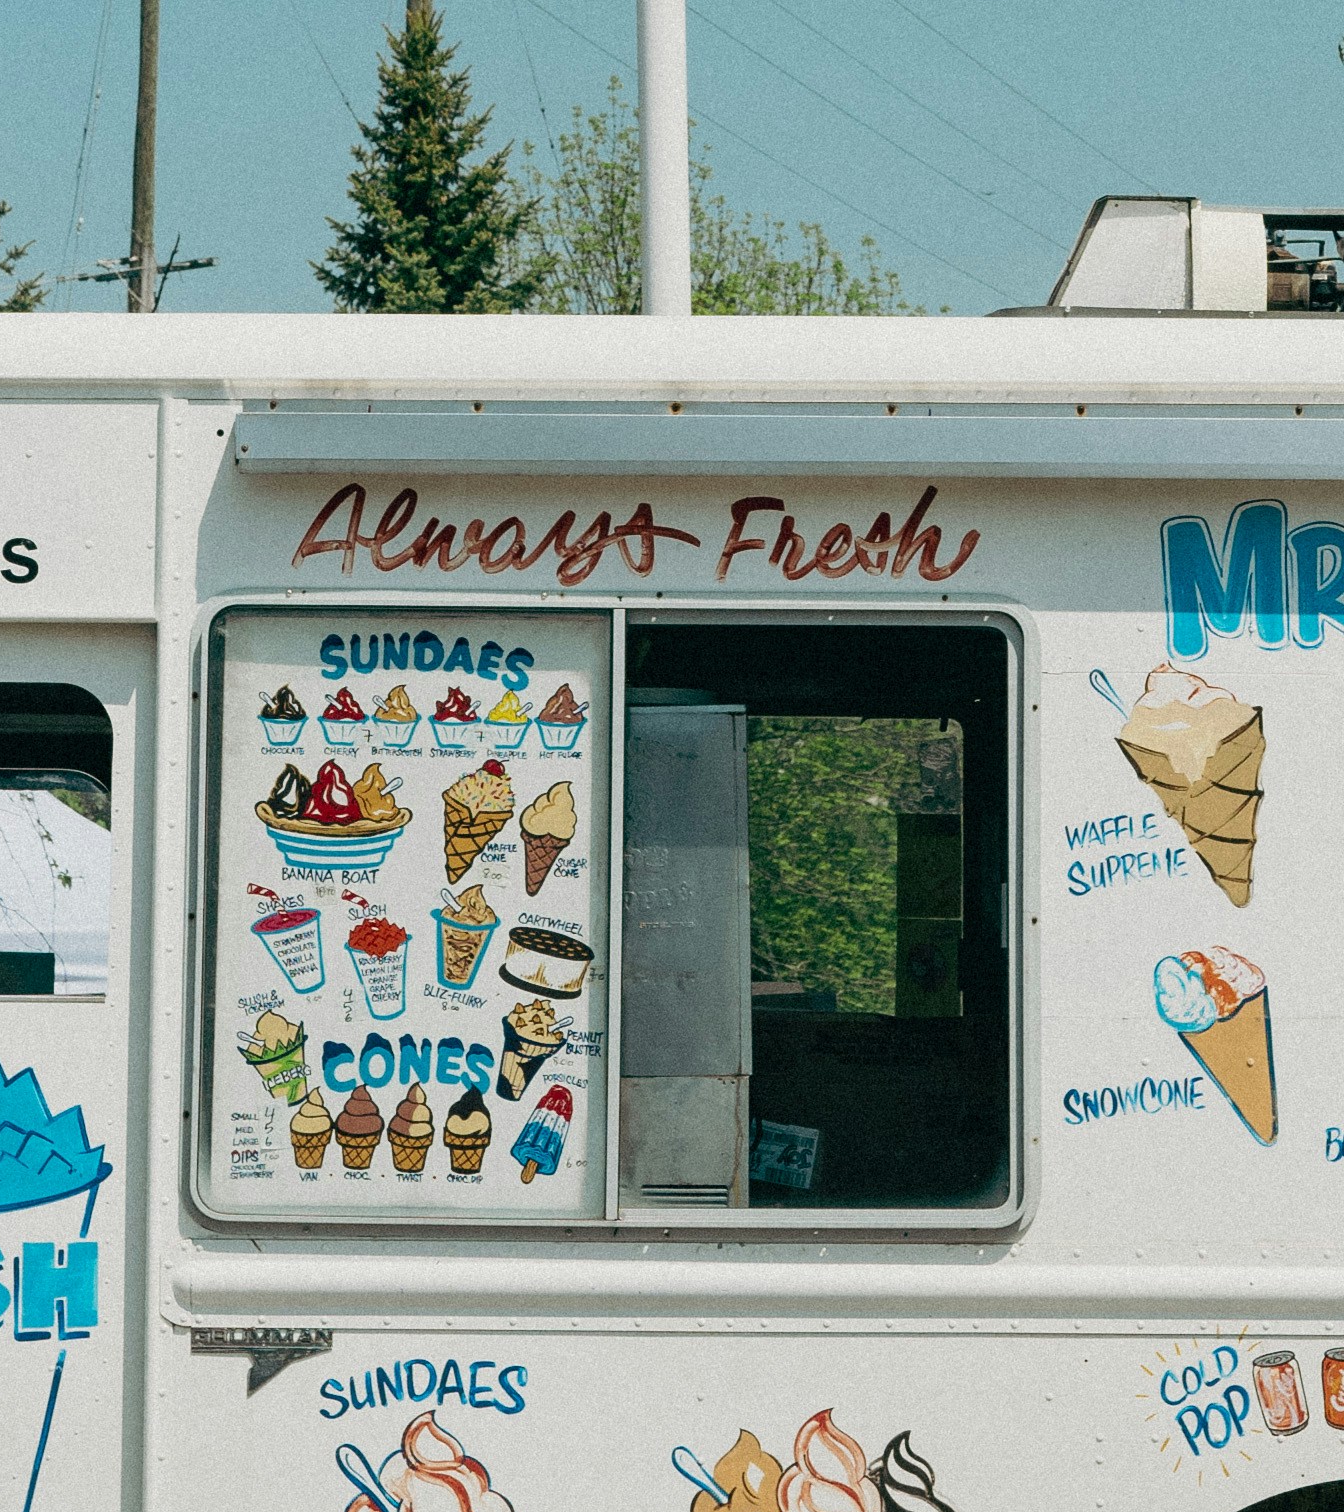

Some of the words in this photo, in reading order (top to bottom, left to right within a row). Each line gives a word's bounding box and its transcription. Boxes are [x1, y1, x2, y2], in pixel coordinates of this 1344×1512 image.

[292, 483, 700, 585] Always
[716, 486, 981, 581] Fresh
[319, 630, 535, 691] SUNDAES
[324, 747, 359, 757] CHERRY
[1064, 813, 1161, 850] WAFFLE
[487, 843, 517, 853] WAFFLE
[481, 853, 506, 863] CONE
[556, 858, 587, 869] SUGAR
[282, 867, 334, 883] BANANA
[342, 869, 379, 884] BOAT
[554, 868, 580, 879] CONE
[257, 894, 304, 914] SHAKES
[348, 904, 386, 921] SLUSH
[518, 912, 583, 936] CARTWHEEL
[344, 989, 353, 1002] 4
[343, 1001, 353, 1013] 5
[345, 1013, 352, 1022] 6
[566, 1029, 604, 1044] PEANUT
[566, 1042, 602, 1057] BUSTER
[322, 1032, 495, 1094] CONES
[262, 1065, 311, 1091] ICEBERG
[1062, 1076, 1207, 1125] SNOWCONE
[265, 1107, 275, 1122] 4
[264, 1122, 274, 1134] 5
[265, 1136, 272, 1146] 6
[231, 1149, 259, 1164] DIPS
[1160, 1346, 1238, 1406] COLD
[319, 1358, 528, 1419] SUNDAES
[1176, 1384, 1250, 1456] POP
